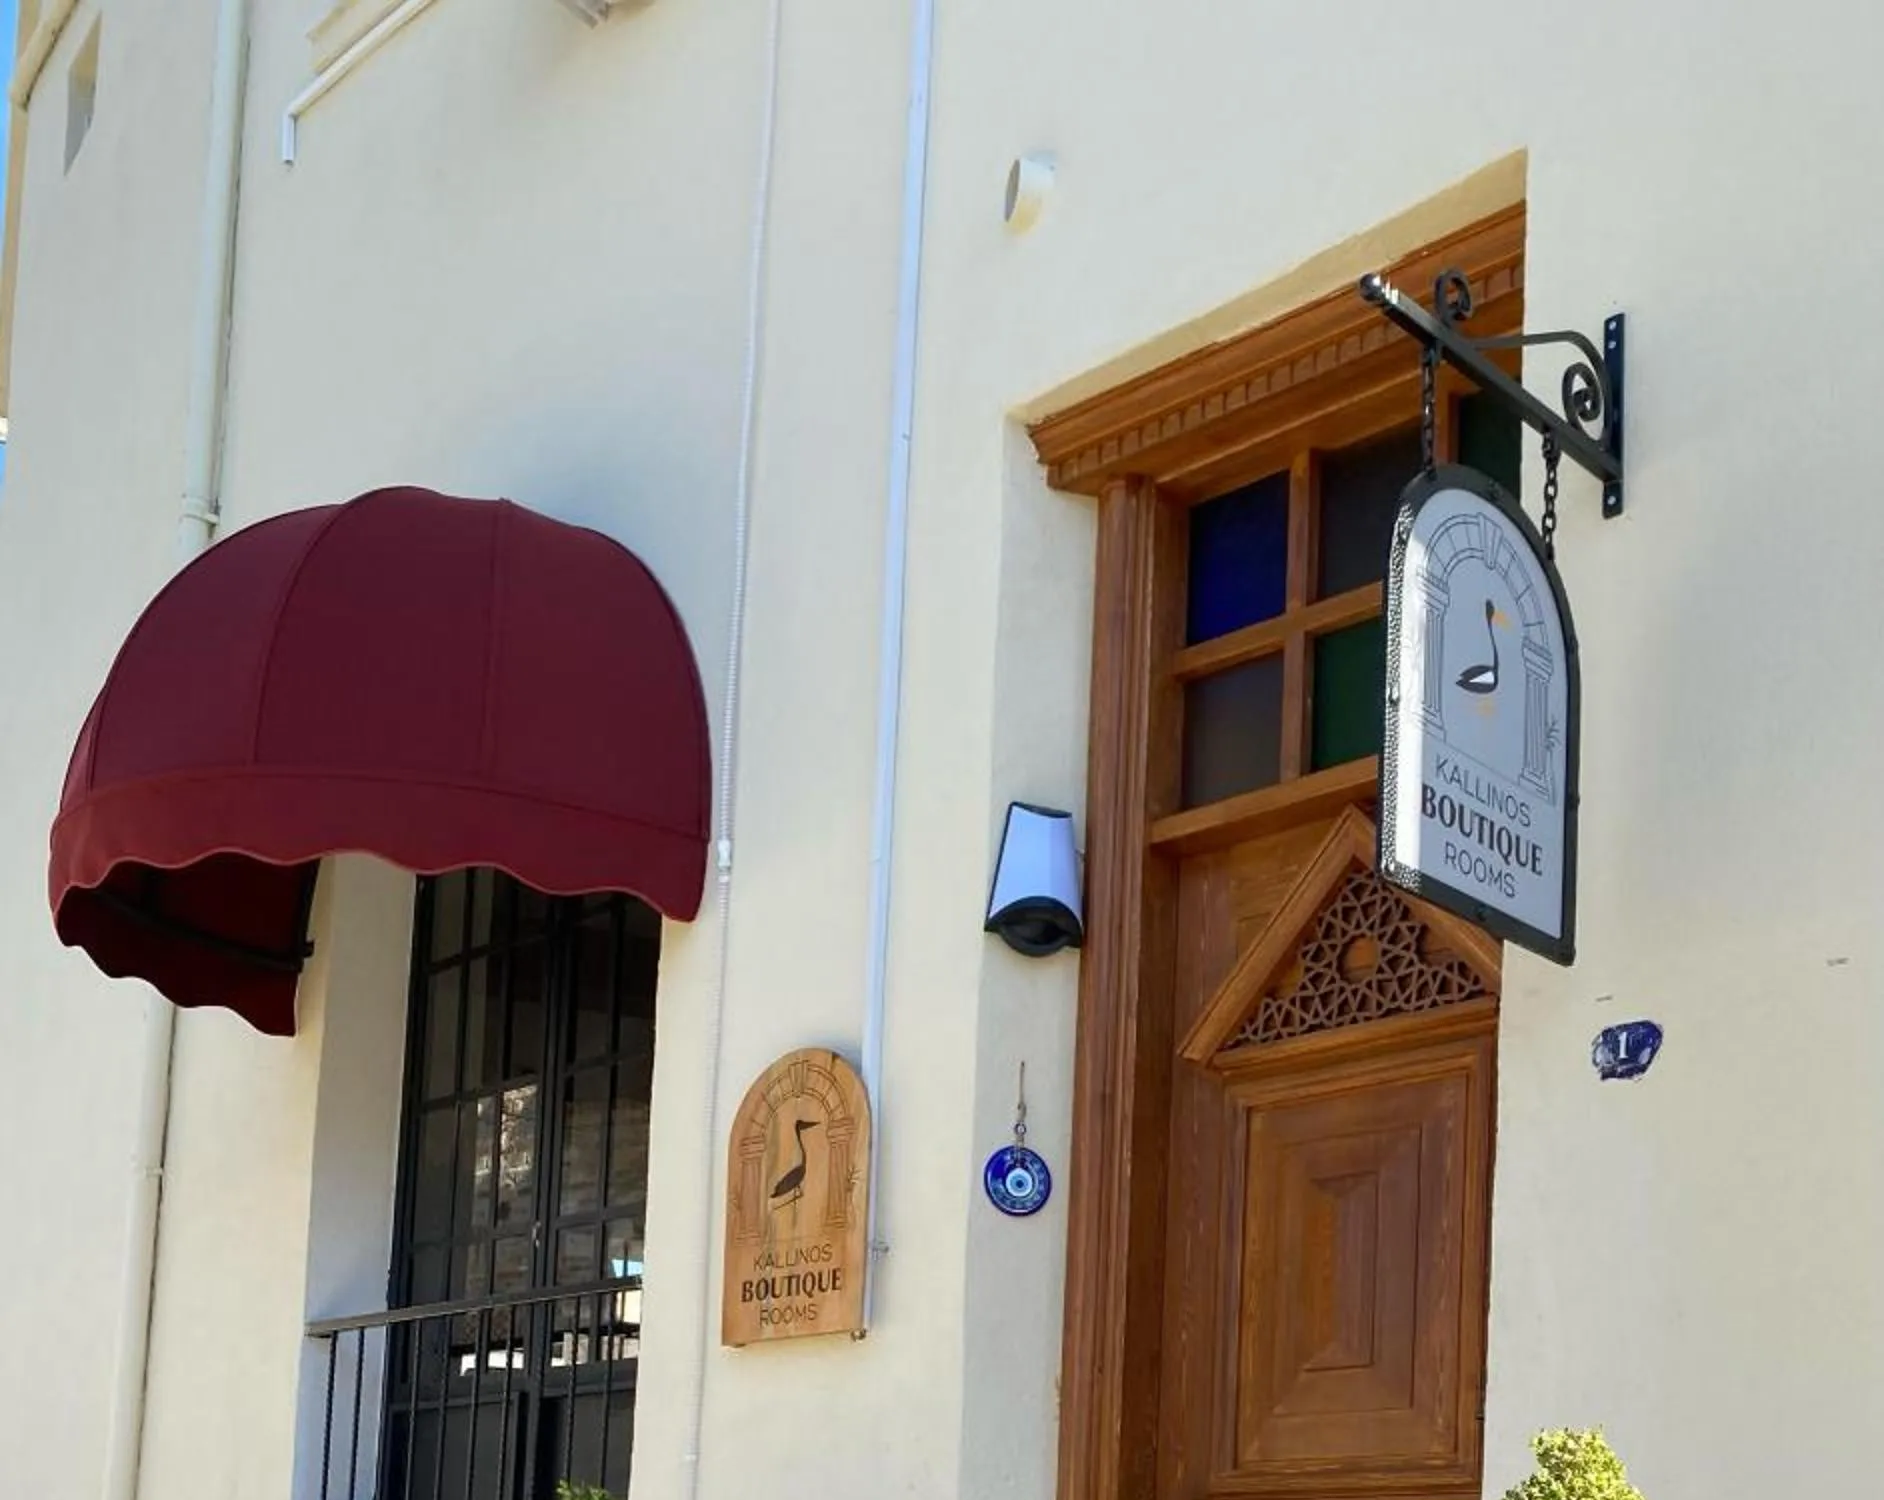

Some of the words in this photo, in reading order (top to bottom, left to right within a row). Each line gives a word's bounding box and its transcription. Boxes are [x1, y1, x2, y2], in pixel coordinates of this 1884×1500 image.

[1435, 753, 1532, 827] KALLINOS
[1421, 783, 1543, 876] BOUTIQUE
[1444, 841, 1517, 899] ROOMS
[1618, 1031, 1628, 1059] 1
[753, 1243, 833, 1272] KALLINOS
[741, 1268, 842, 1302] BOUTIQUE
[759, 1303, 819, 1328] ROOMS
